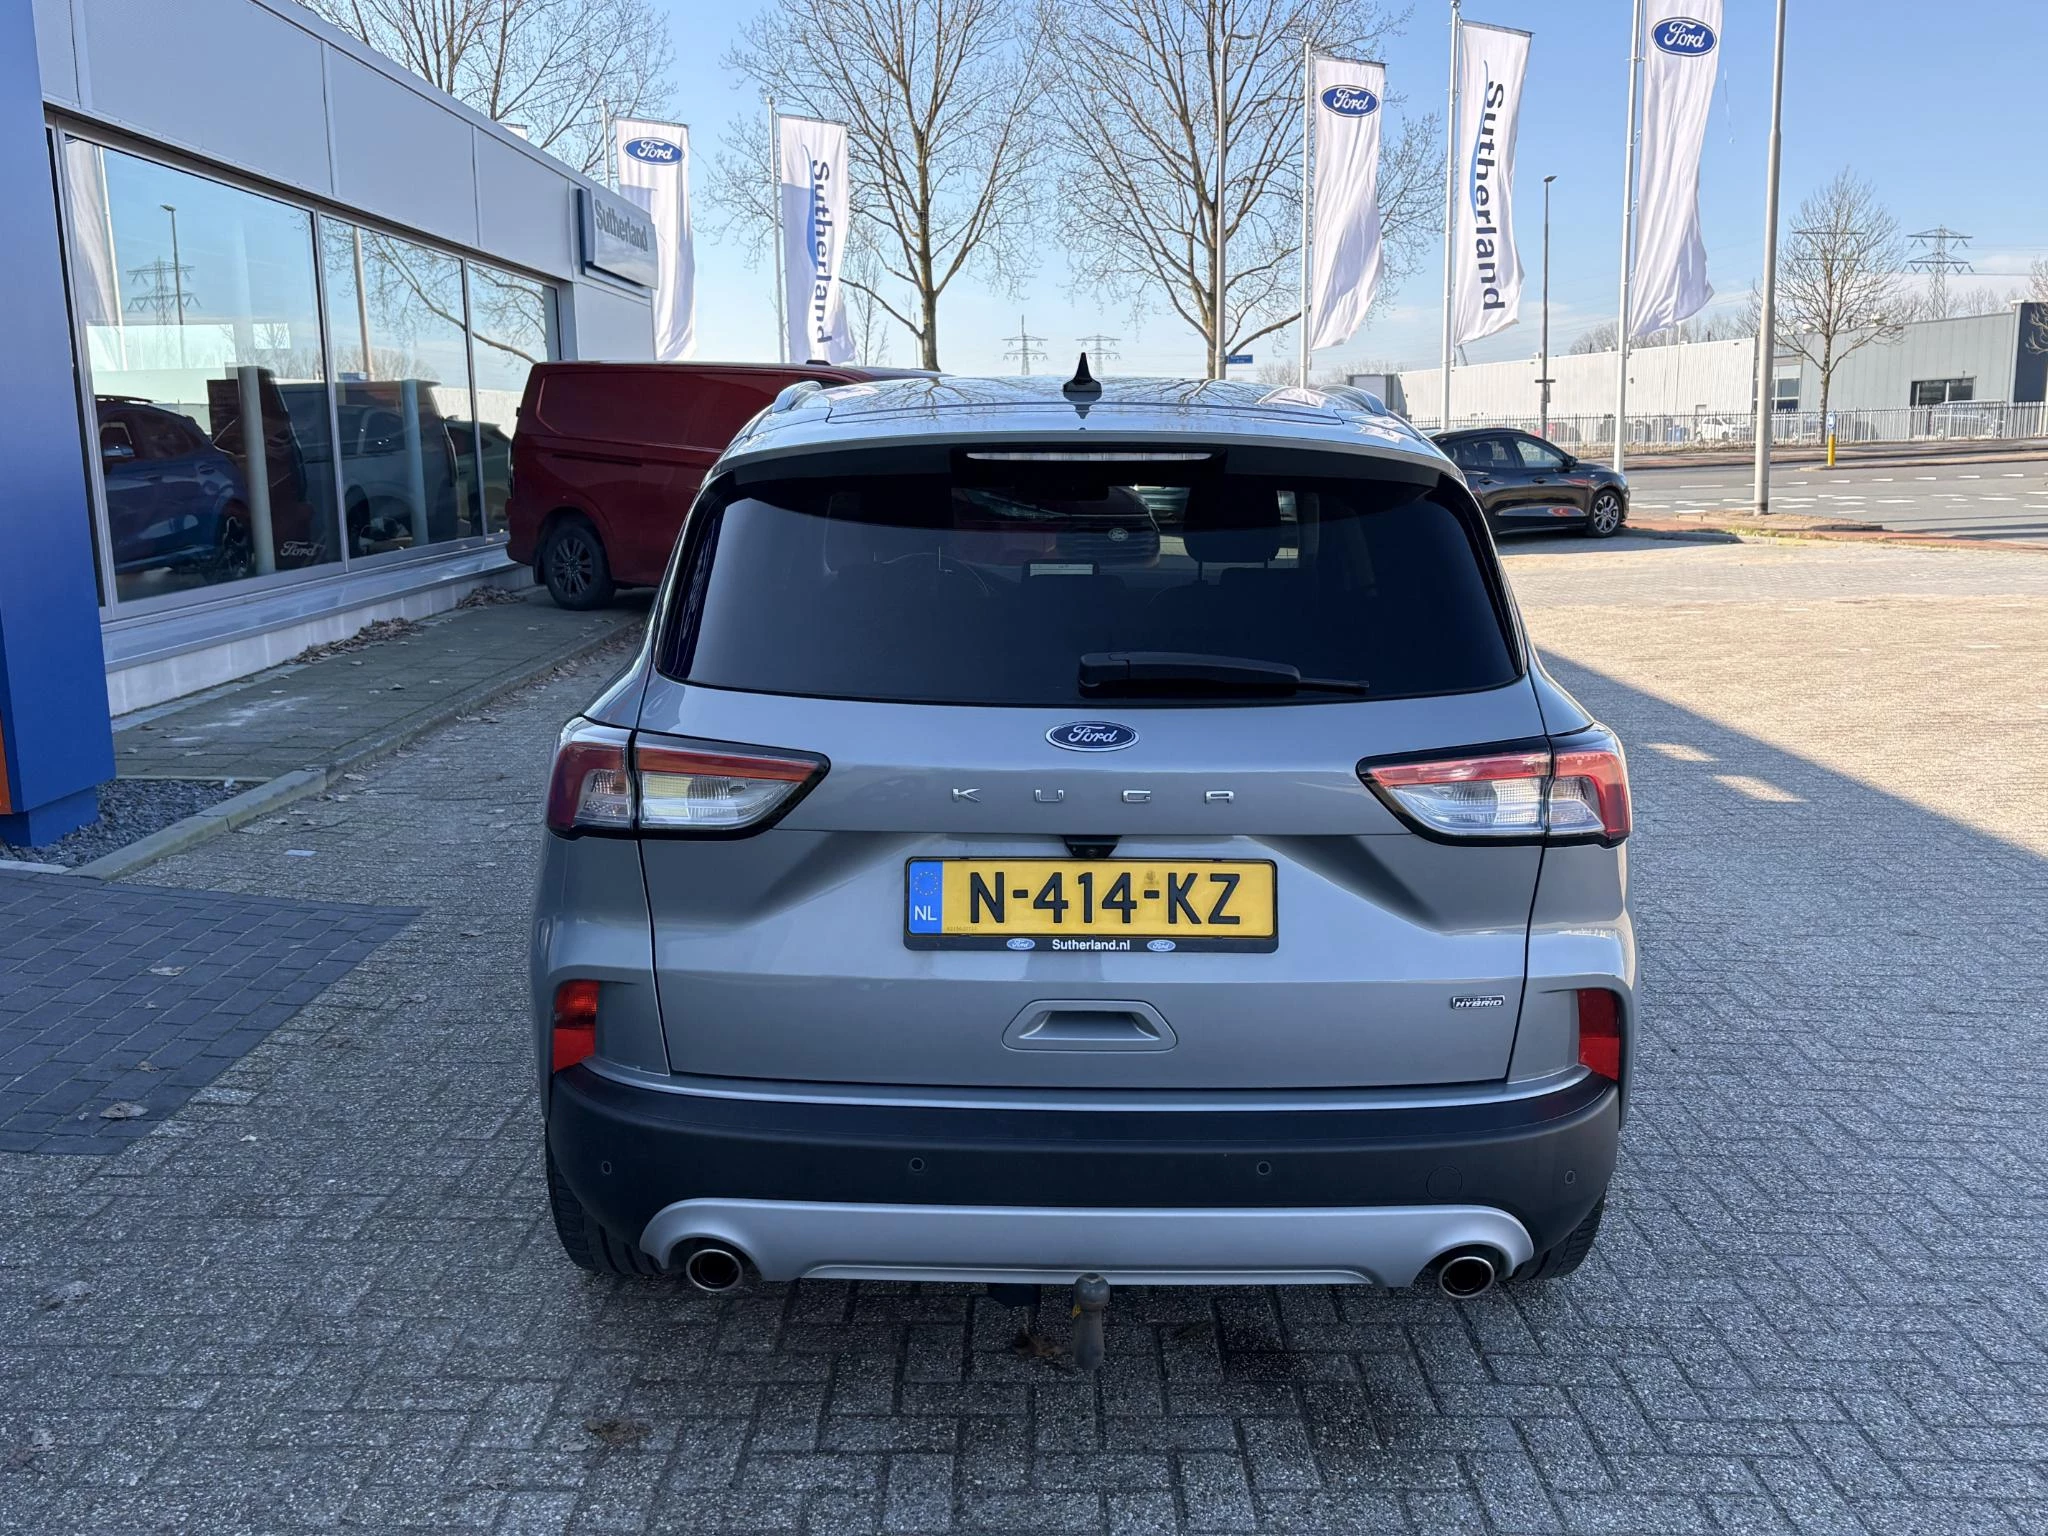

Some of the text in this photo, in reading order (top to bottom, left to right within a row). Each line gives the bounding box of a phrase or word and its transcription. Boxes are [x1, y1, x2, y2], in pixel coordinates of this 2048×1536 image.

[1664, 20, 1706, 49] Ford
[1333, 88, 1369, 111] Ford
[636, 139, 673, 161] Ford
[1475, 80, 1506, 311] Sutherland
[594, 199, 649, 253] Sutherland
[811, 159, 833, 343] Sutherland
[280, 540, 319, 557] Ford
[1067, 726, 1118, 744] Ford
[952, 788, 1235, 804] KUGA
[970, 871, 1241, 925] N-414-KZ
[914, 905, 938, 921] NL
[1052, 939, 1131, 951] Sutherland.nl
